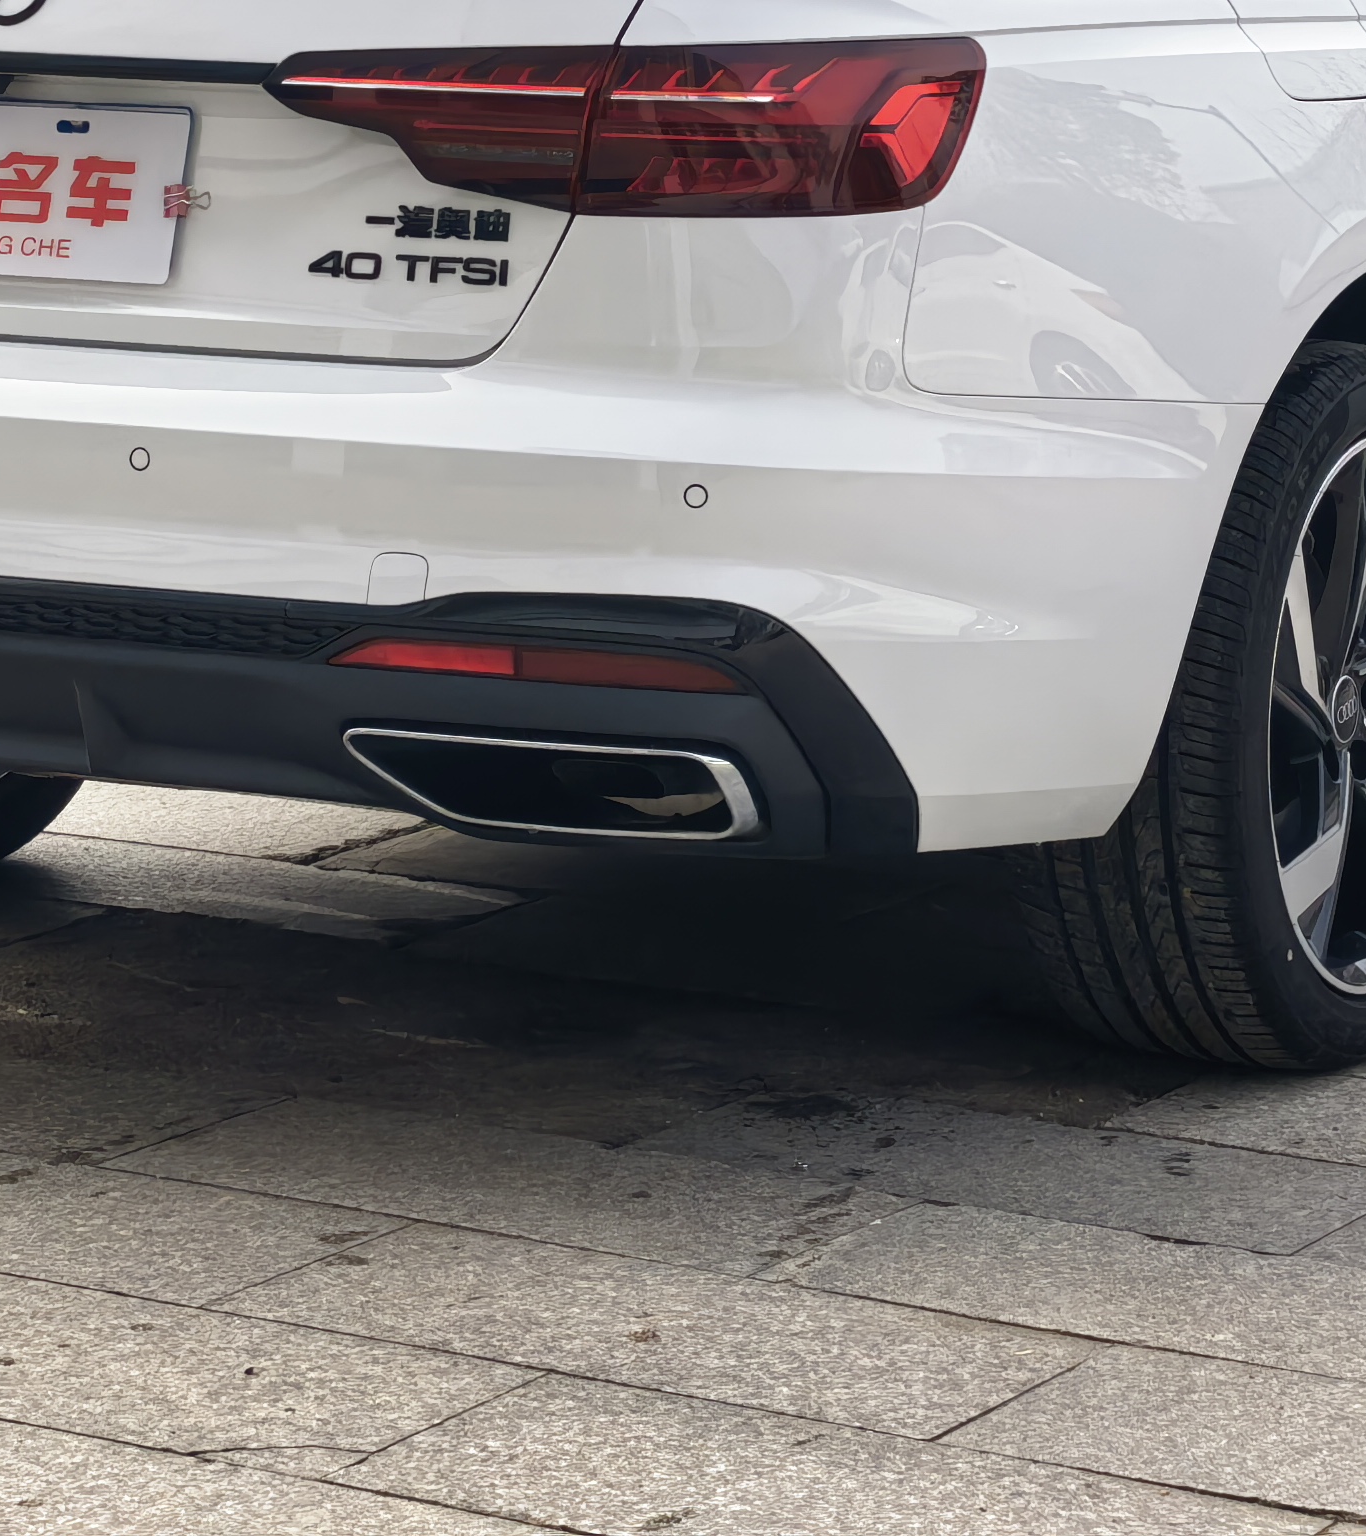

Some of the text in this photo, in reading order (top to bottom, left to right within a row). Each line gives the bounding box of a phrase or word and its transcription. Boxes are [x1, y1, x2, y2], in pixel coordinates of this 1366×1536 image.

[20, 236, 73, 259] CHE
[308, 249, 510, 287] 40 TFSI
